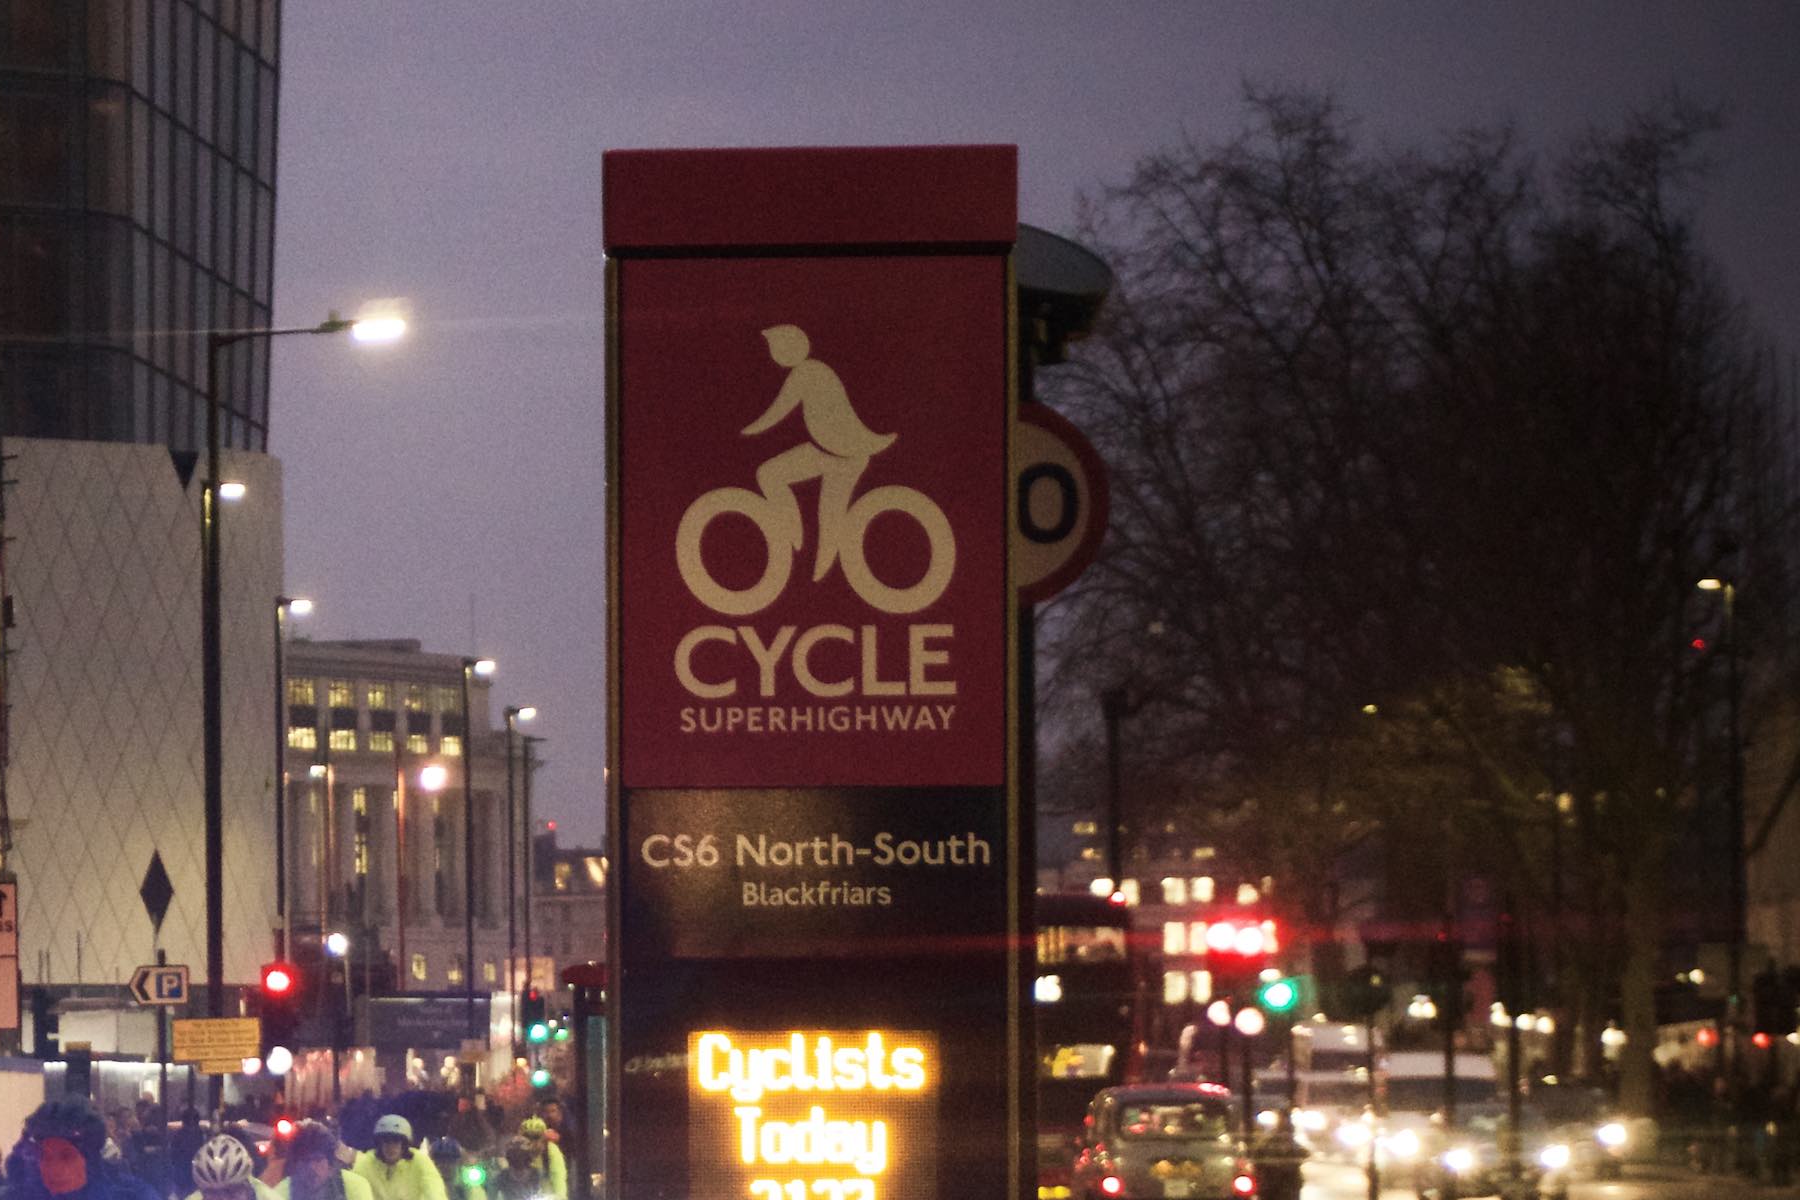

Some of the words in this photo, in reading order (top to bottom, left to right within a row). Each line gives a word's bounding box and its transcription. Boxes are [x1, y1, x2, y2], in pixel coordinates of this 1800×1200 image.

[1018, 463, 1079, 544] 0
[674, 623, 958, 699] CYCLE
[679, 705, 957, 733] SUPERHIGHWAY
[641, 833, 719, 868] CS6
[736, 832, 991, 867] North-South
[742, 881, 892, 906] Blackfriars
[698, 1031, 926, 1101] Cyclists
[734, 1105, 888, 1175] Today
